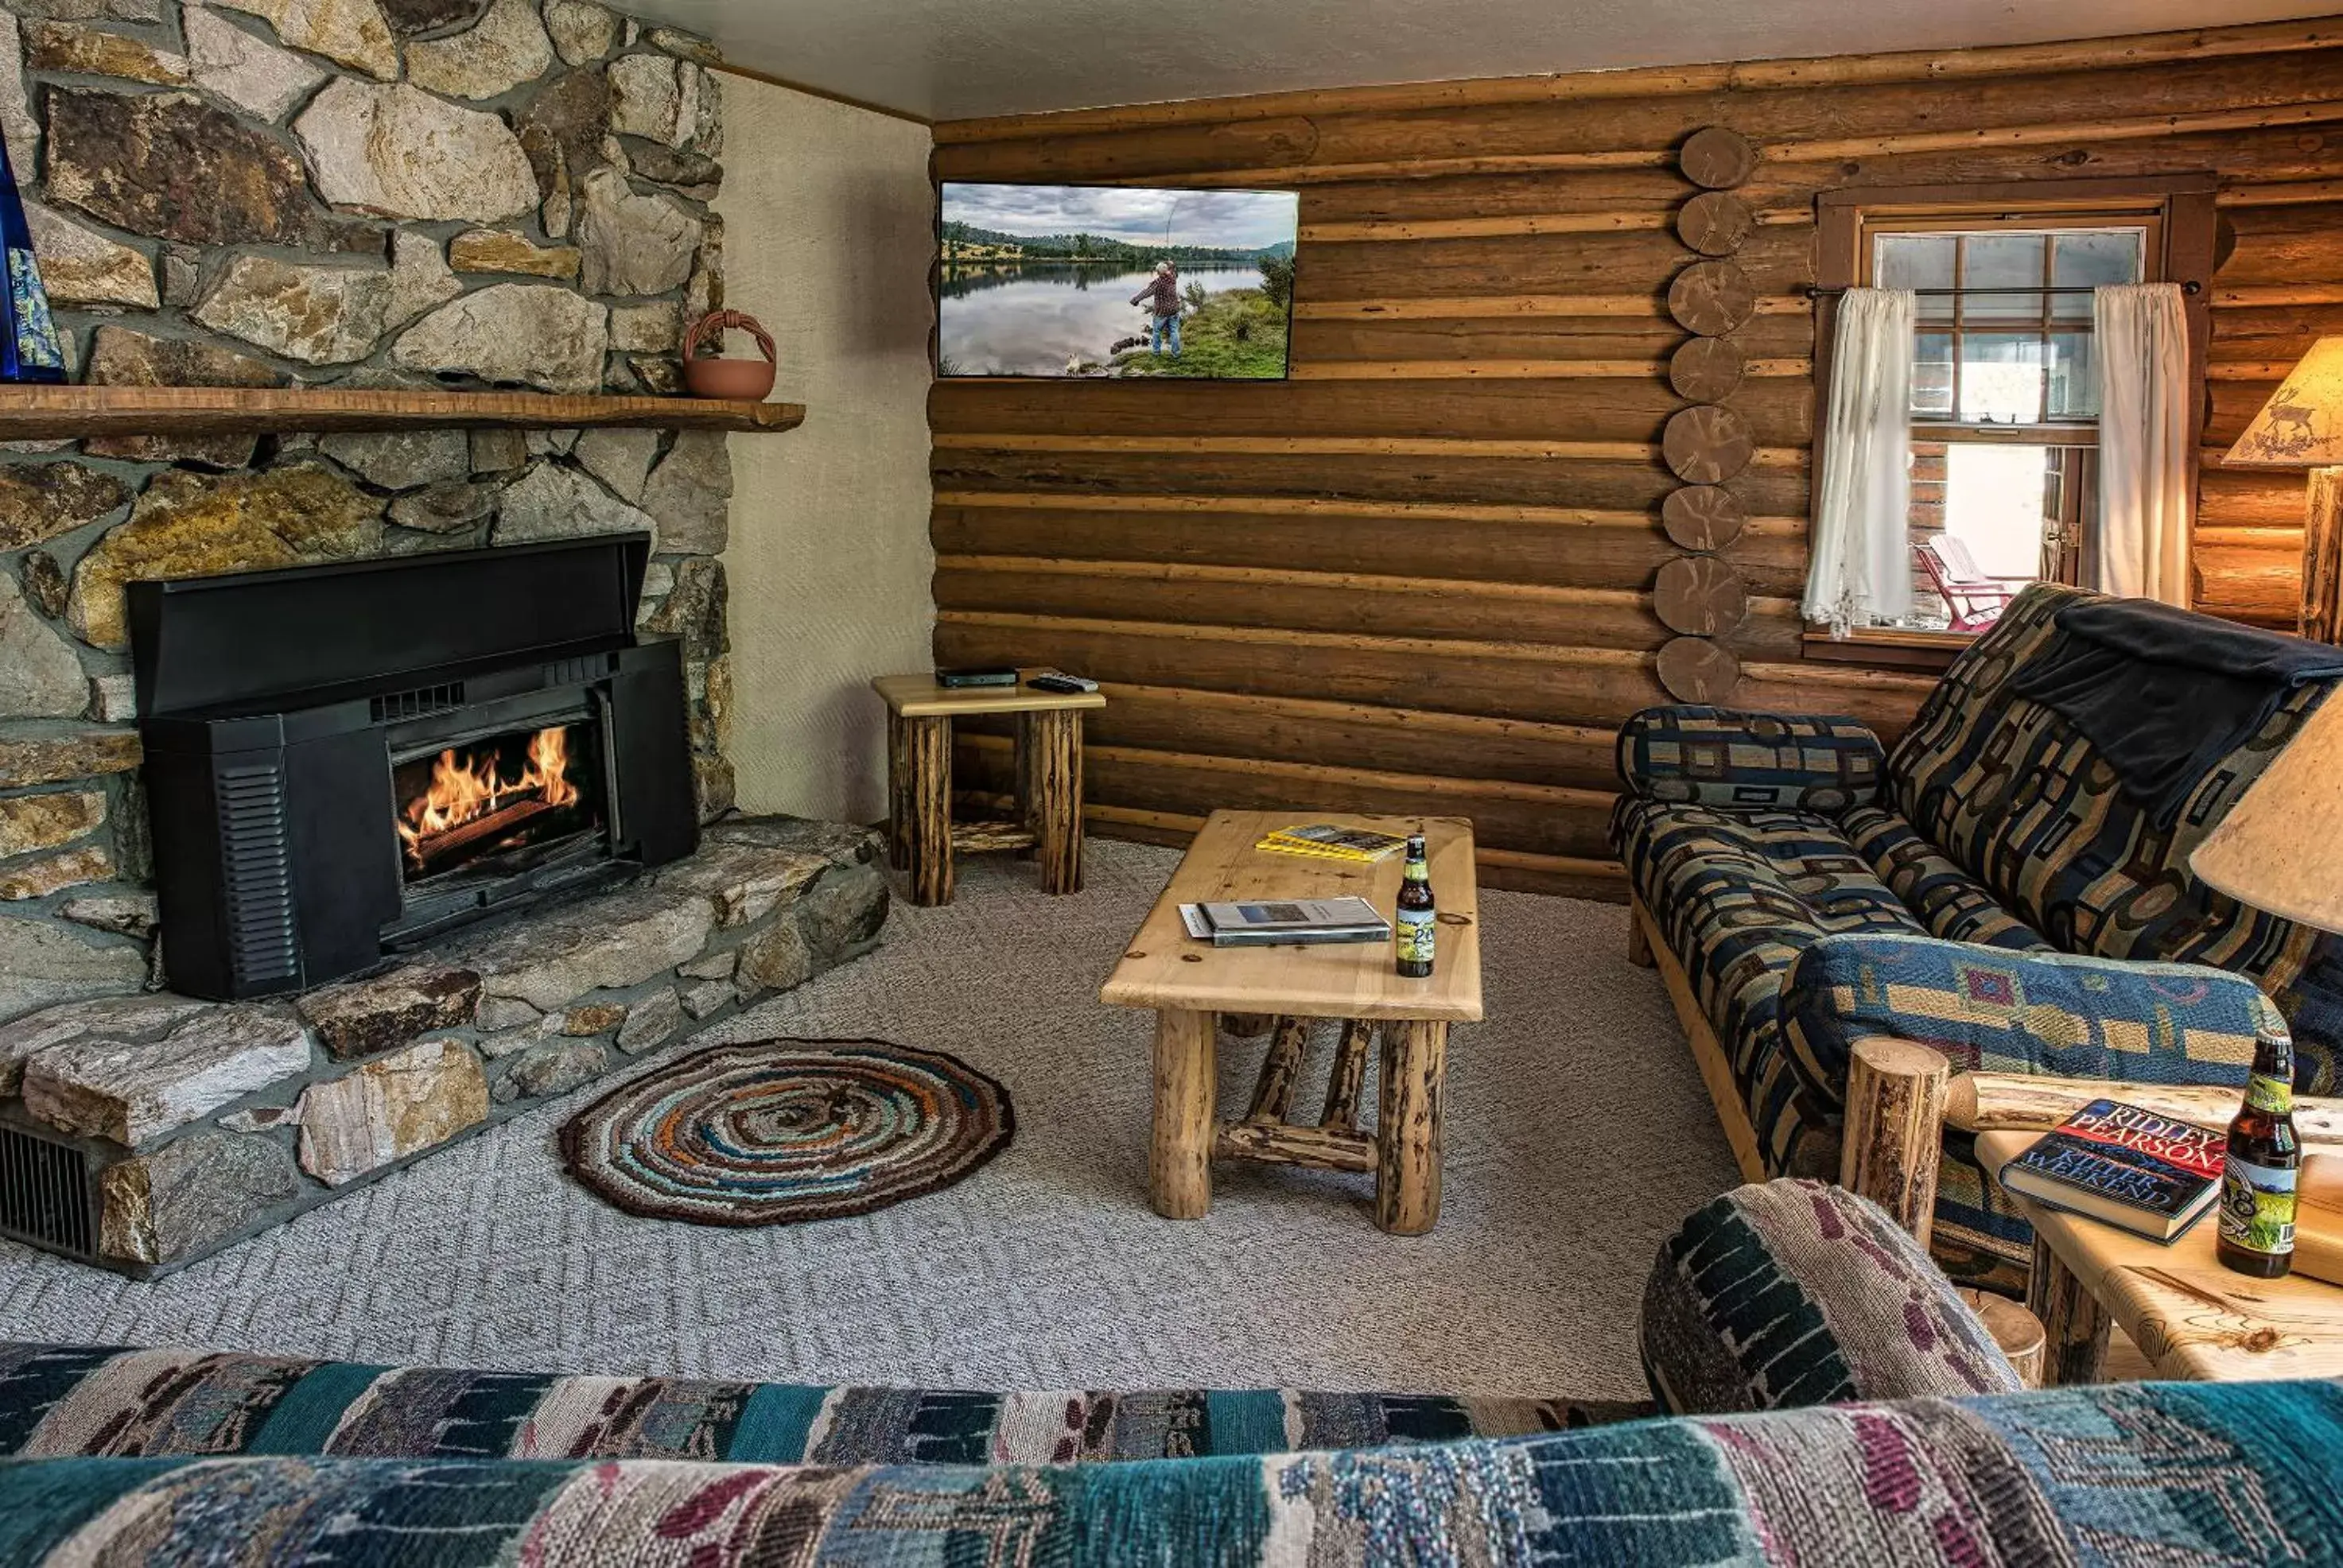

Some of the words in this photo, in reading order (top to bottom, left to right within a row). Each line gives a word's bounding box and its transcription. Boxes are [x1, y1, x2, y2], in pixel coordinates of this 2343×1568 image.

[2070, 1113, 2225, 1169] PEARSON
[2106, 1105, 2226, 1150] RIDLEY
[2026, 1151, 2171, 1205] WEEKEND
[2060, 1149, 2158, 1190] KILLER
